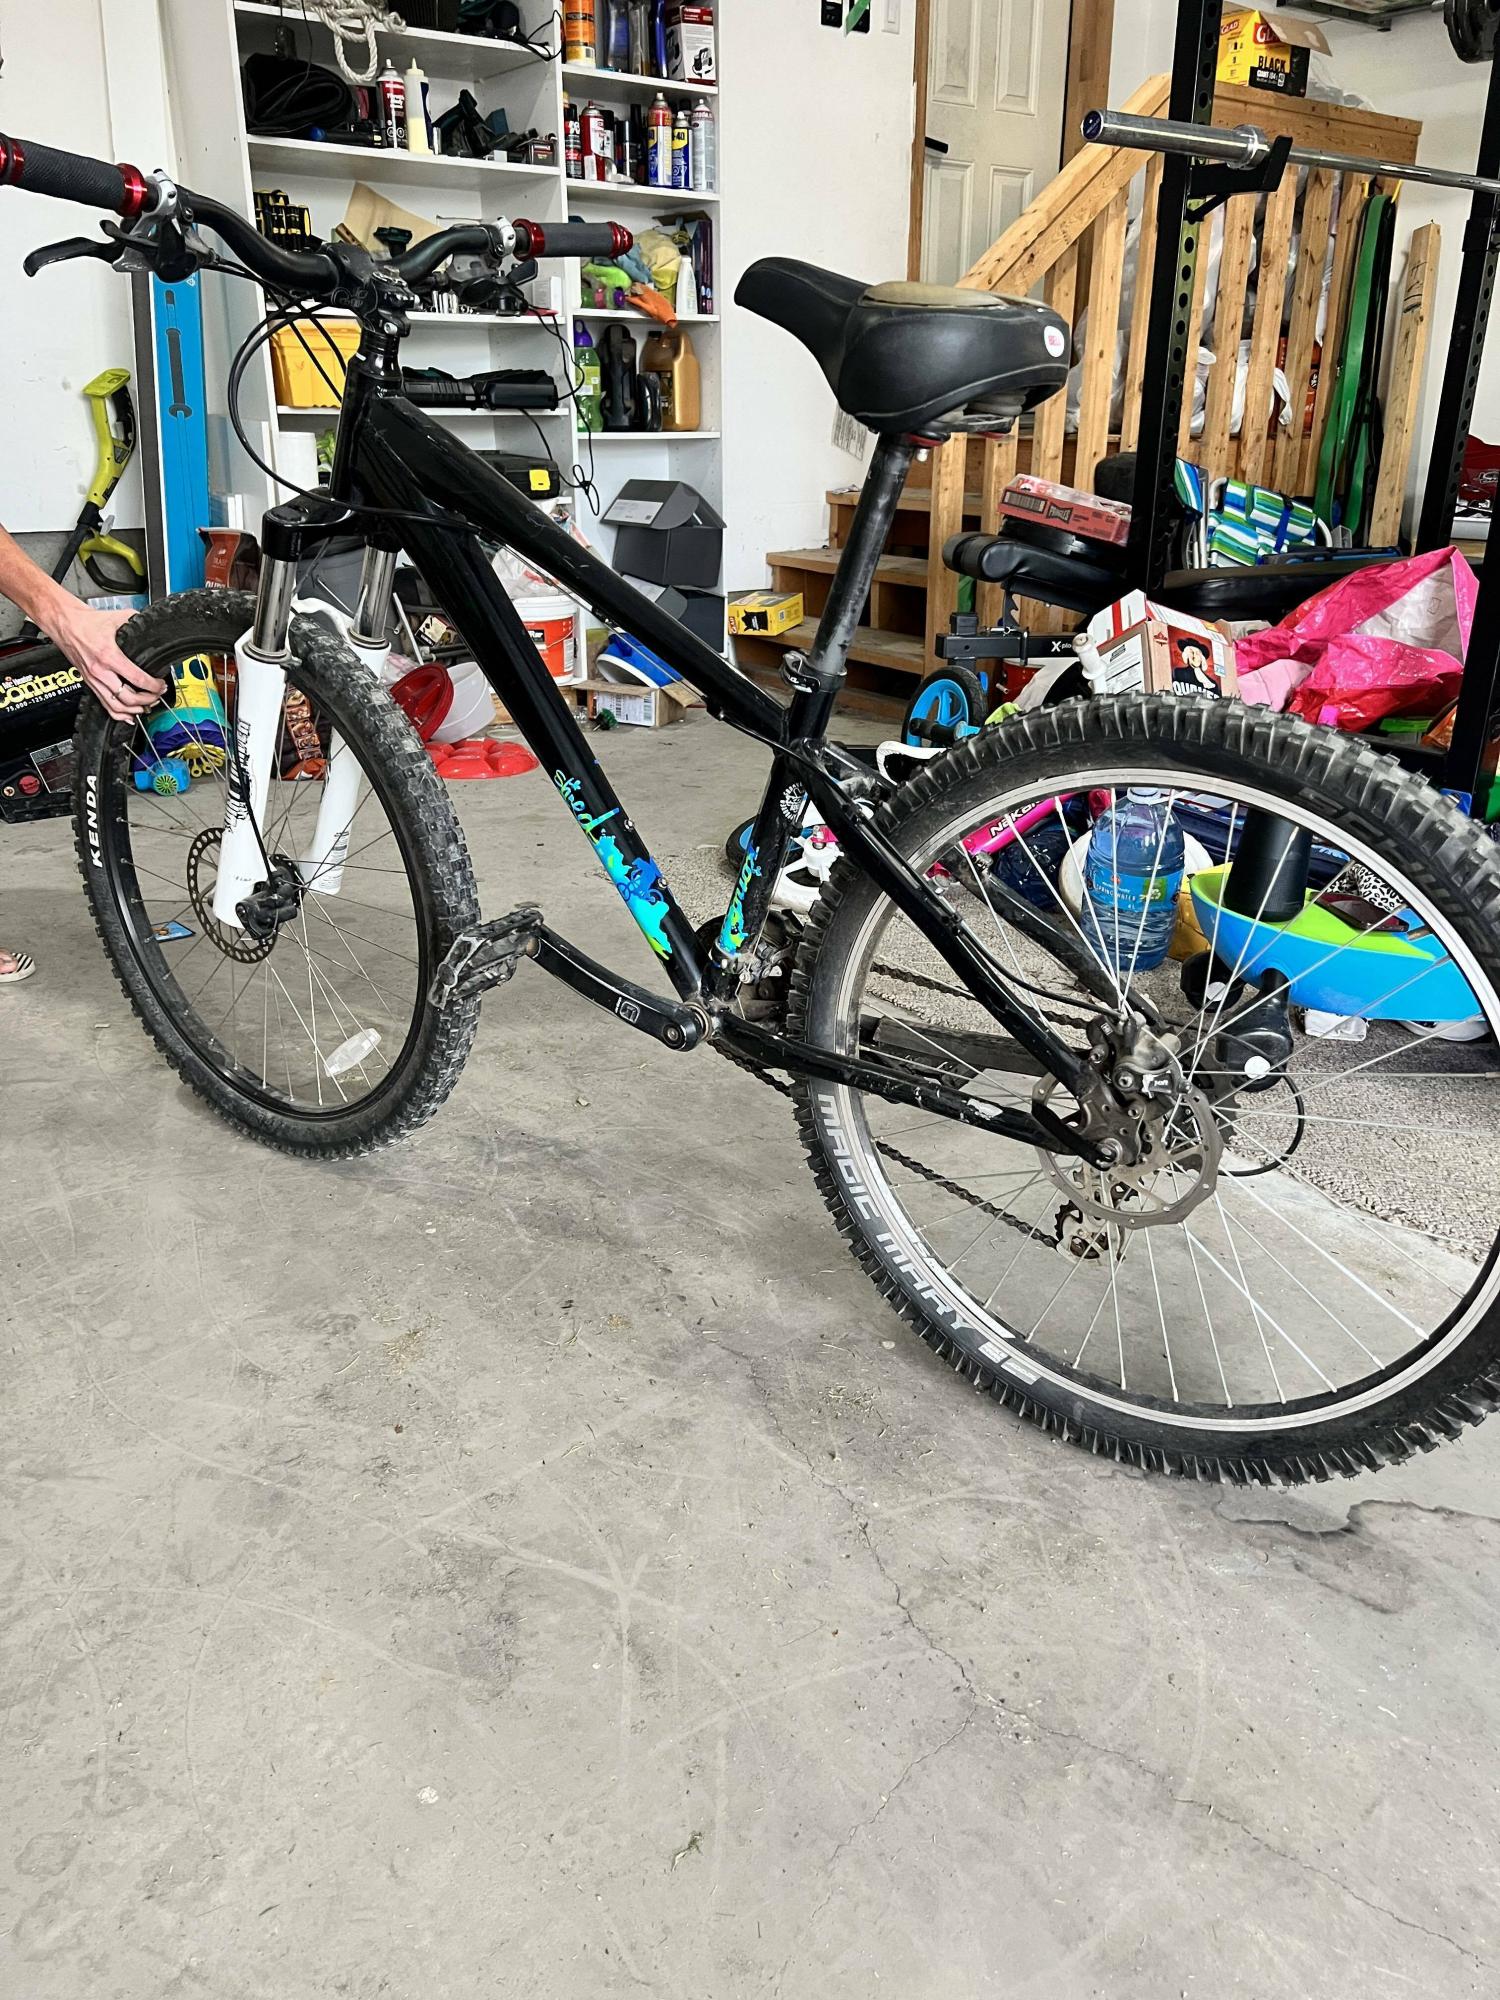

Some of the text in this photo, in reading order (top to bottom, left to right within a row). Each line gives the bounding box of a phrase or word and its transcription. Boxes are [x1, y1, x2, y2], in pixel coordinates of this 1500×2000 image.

[1258, 55, 1286, 73] BLACK
[86, 775, 103, 868] KENDA
[817, 1093, 976, 1330] MAGIC MARY
